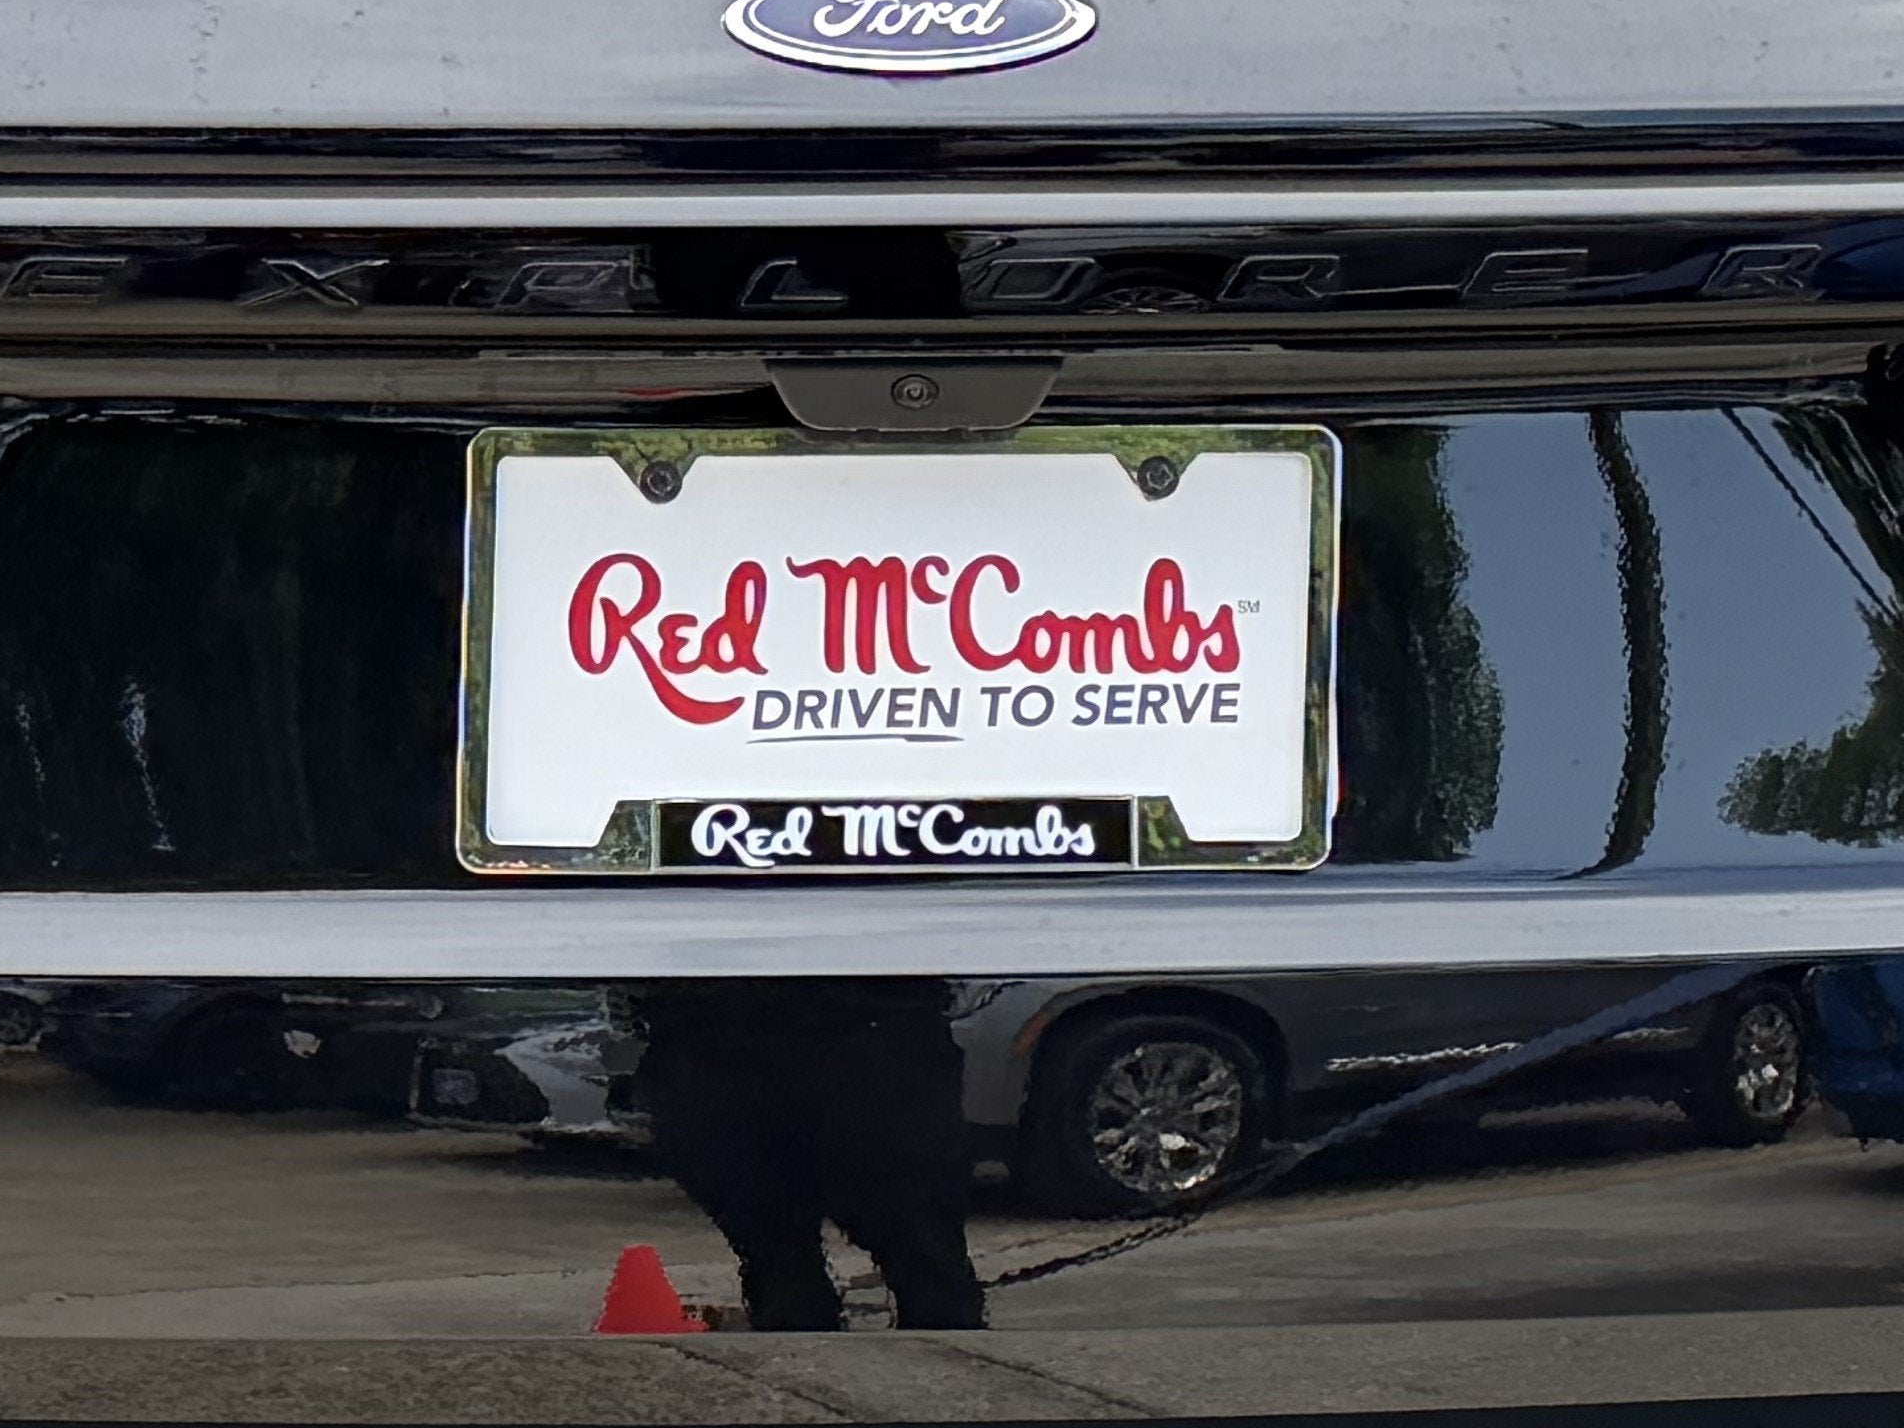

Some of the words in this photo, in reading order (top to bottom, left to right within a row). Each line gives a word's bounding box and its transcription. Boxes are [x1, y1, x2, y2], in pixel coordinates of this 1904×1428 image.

[567, 552, 770, 725] Red
[786, 553, 1242, 676] McCombs
[751, 687, 962, 731] DRIVEN
[981, 684, 1055, 729] TO
[1072, 682, 1242, 726] SERVE
[690, 803, 812, 869] Red
[821, 803, 1096, 858] McCombs
